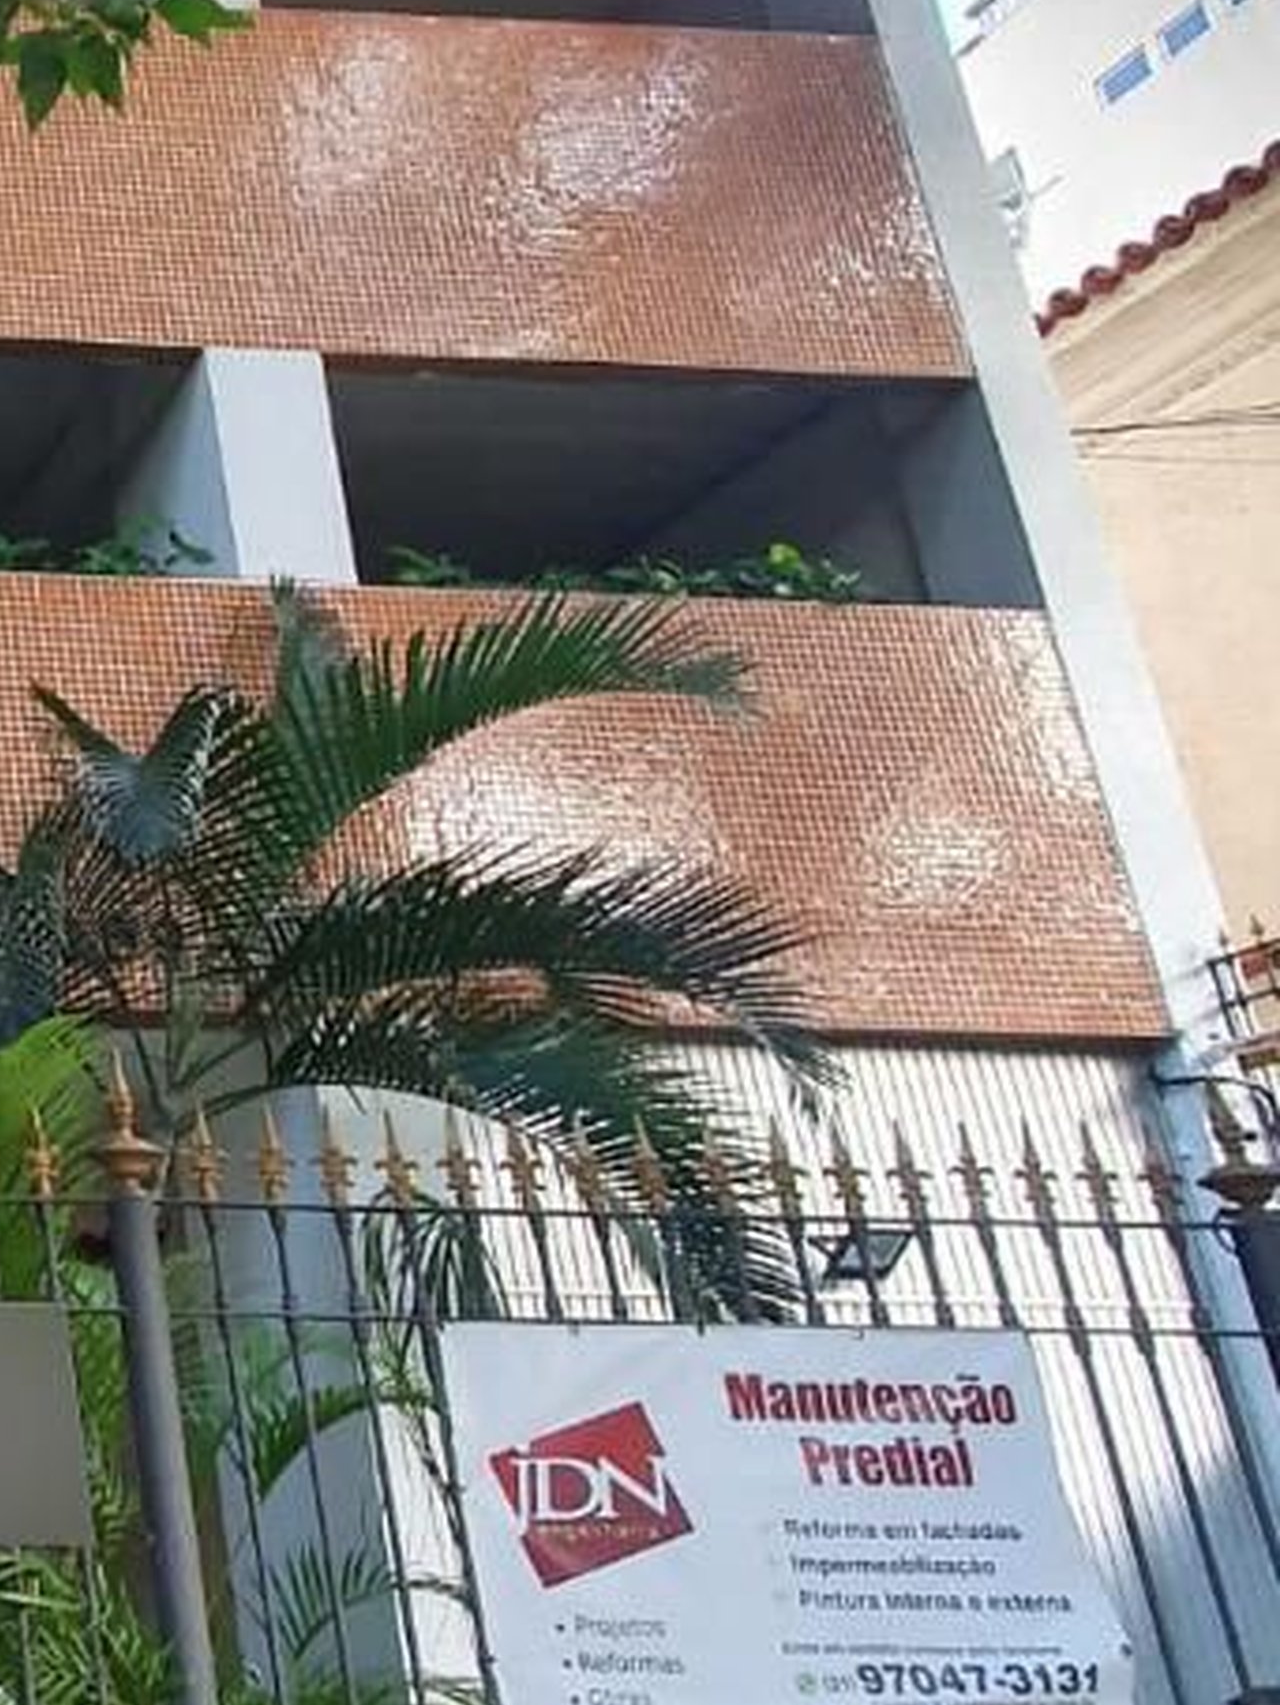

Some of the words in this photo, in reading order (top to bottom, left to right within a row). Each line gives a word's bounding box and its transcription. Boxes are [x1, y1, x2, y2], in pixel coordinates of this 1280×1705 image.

[724, 1372, 1018, 1434] Manutenção
[799, 1436, 974, 1487] Predial
[509, 1454, 669, 1536] JDN
[784, 1518, 878, 1541] Reforma
[883, 1523, 917, 1540] em
[921, 1520, 1023, 1542] fachadas
[798, 1589, 881, 1611] Pintura
[988, 1594, 1072, 1613] externa
[574, 1614, 667, 1641] Projetos
[578, 1652, 687, 1675] Reformas
[856, 1662, 1100, 1695] 97047-3131
